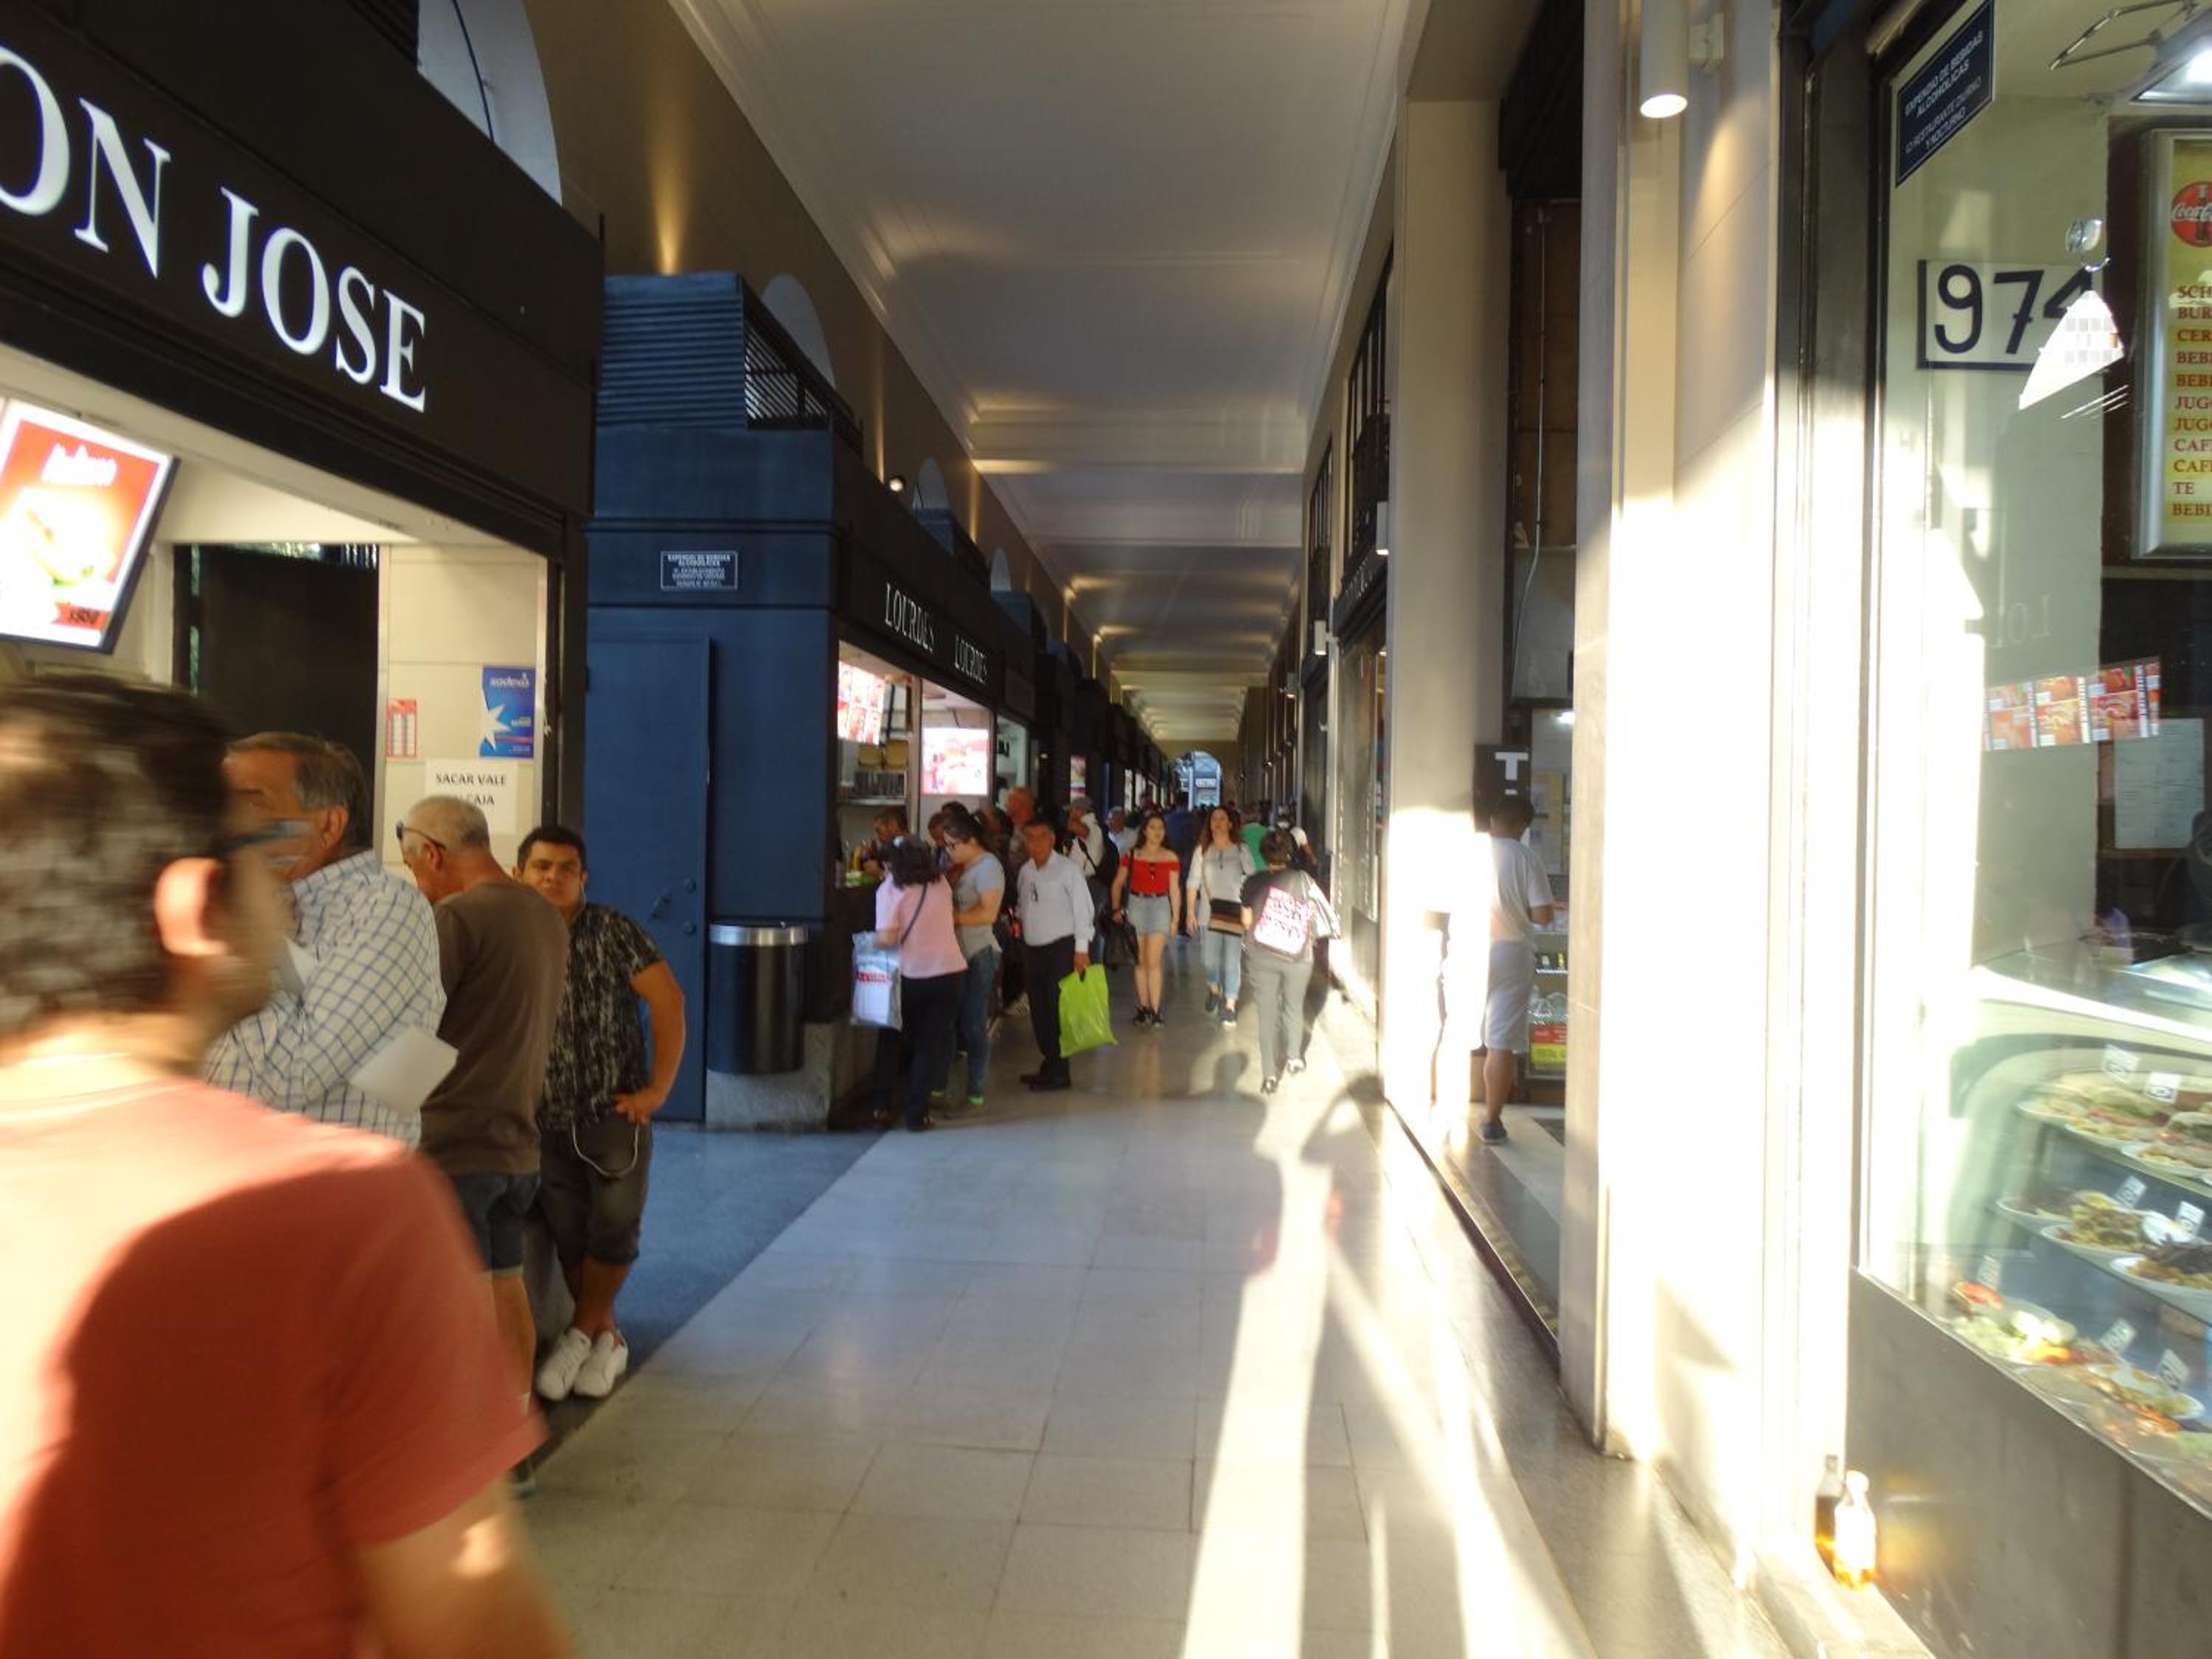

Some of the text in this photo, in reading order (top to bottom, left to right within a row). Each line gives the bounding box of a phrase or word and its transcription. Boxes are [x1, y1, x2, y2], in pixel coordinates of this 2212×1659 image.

[0, 45, 425, 413] ON JOSE
[2175, 396, 2212, 409] JUG
[2175, 418, 2212, 431] JUG
[2173, 481, 2194, 495] TE
[436, 772, 507, 785] SACAR VALE
